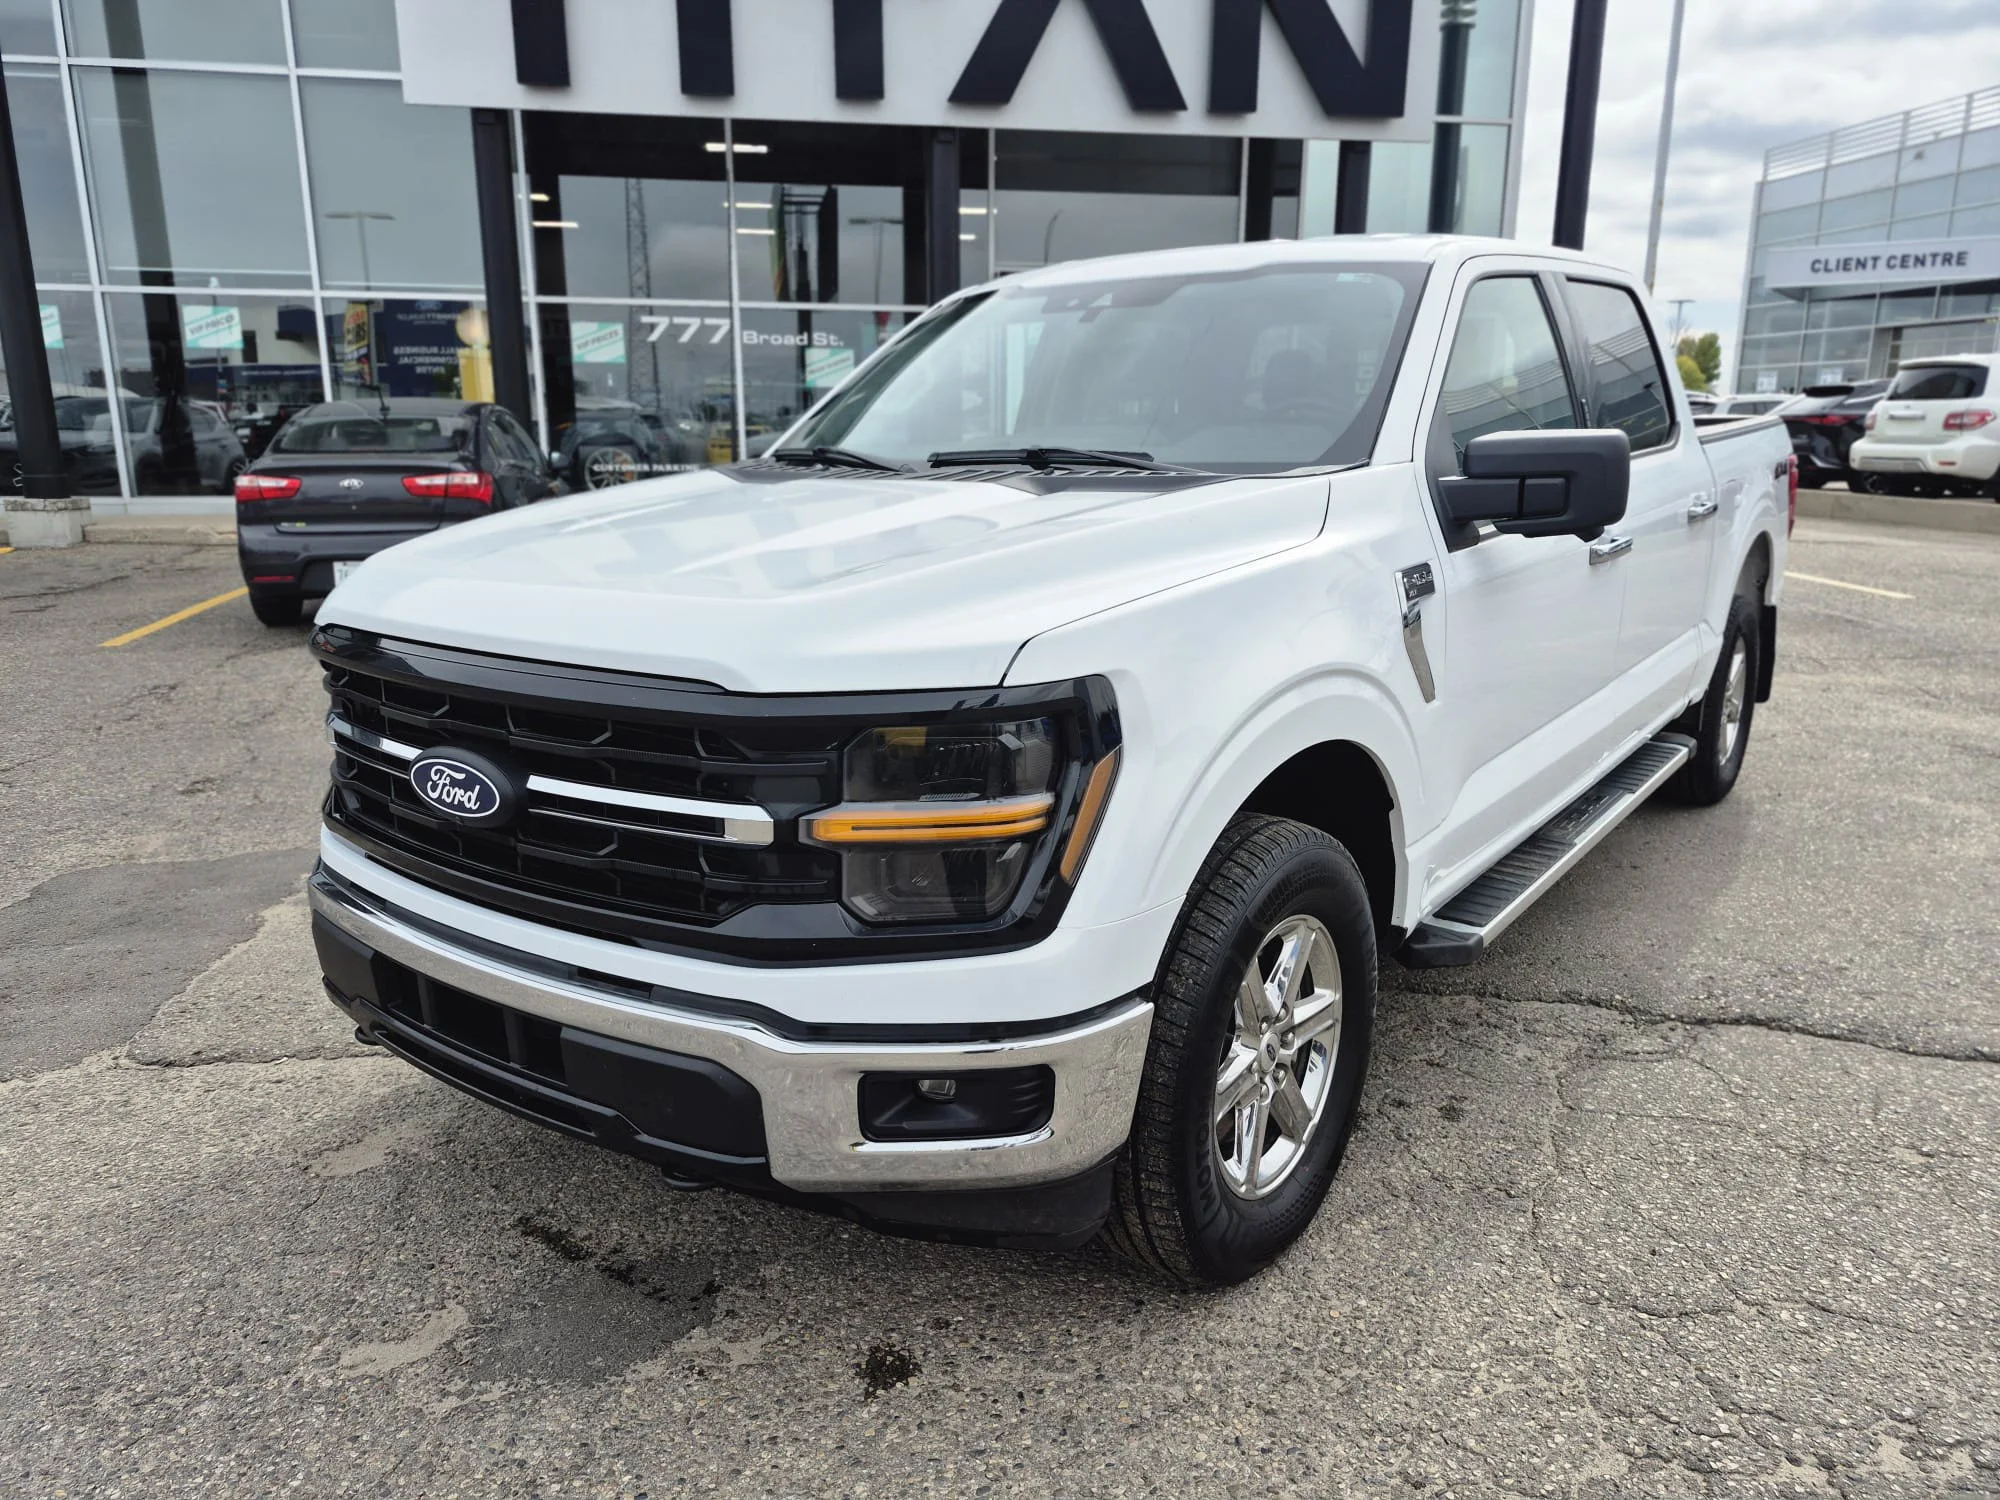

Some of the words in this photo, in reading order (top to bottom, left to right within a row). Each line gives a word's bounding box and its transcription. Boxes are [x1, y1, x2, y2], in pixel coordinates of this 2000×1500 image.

[1810, 255, 1881, 273] CLIENT
[1886, 250, 1969, 269] CENTRE
[640, 316, 731, 344] 777
[742, 330, 809, 346] Broad
[812, 332, 845, 346] St.
[592, 463, 650, 472] CUSTOMER
[427, 765, 480, 810] Ford
